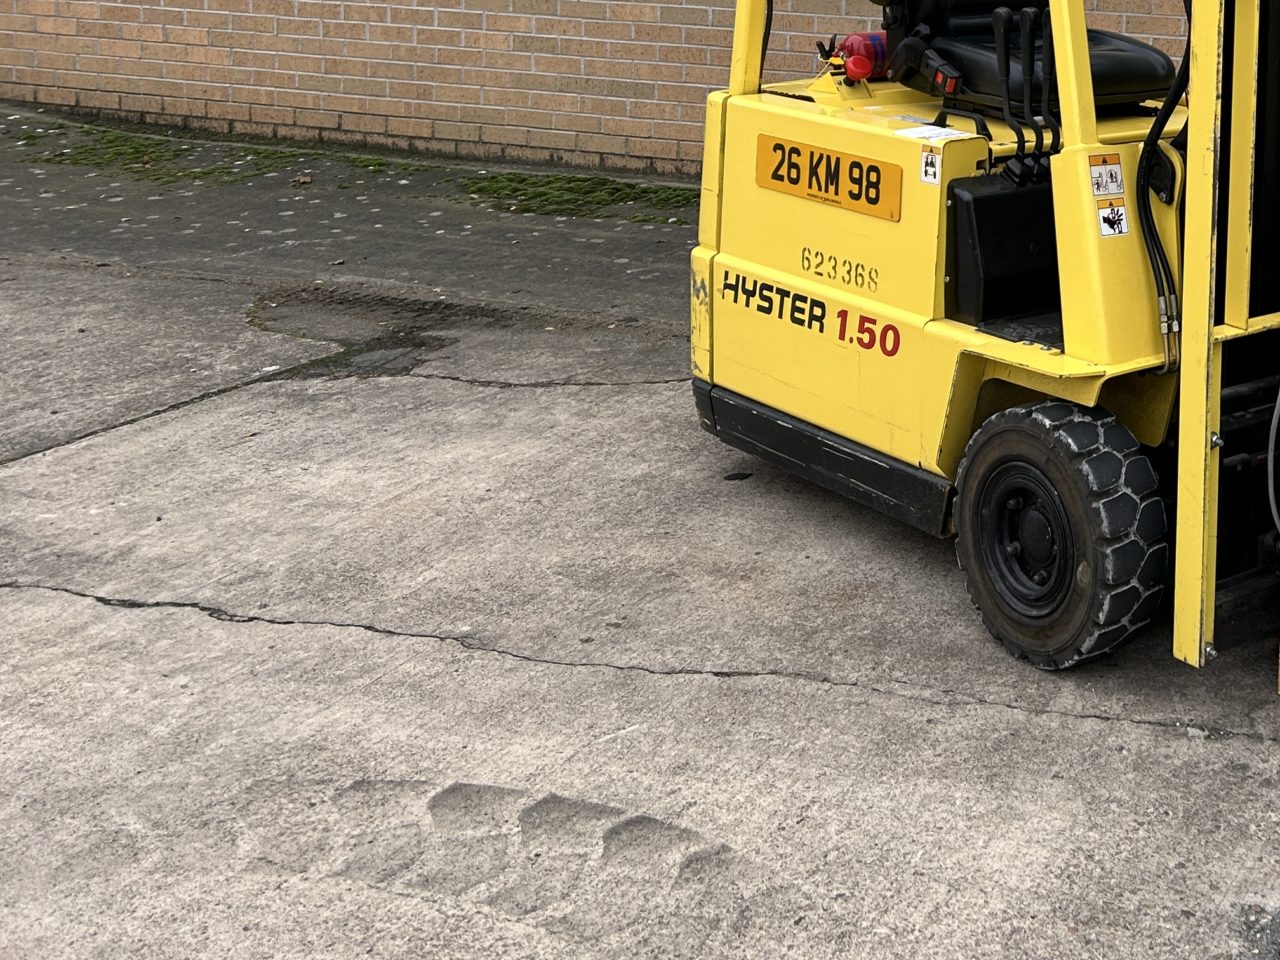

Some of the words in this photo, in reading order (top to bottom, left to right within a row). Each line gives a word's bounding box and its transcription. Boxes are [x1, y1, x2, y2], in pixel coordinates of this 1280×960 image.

[771, 142, 802, 186] 26
[807, 150, 841, 197] KM
[848, 160, 881, 206] 98
[722, 270, 827, 334] HYSTER
[836, 309, 901, 357] 1.50
